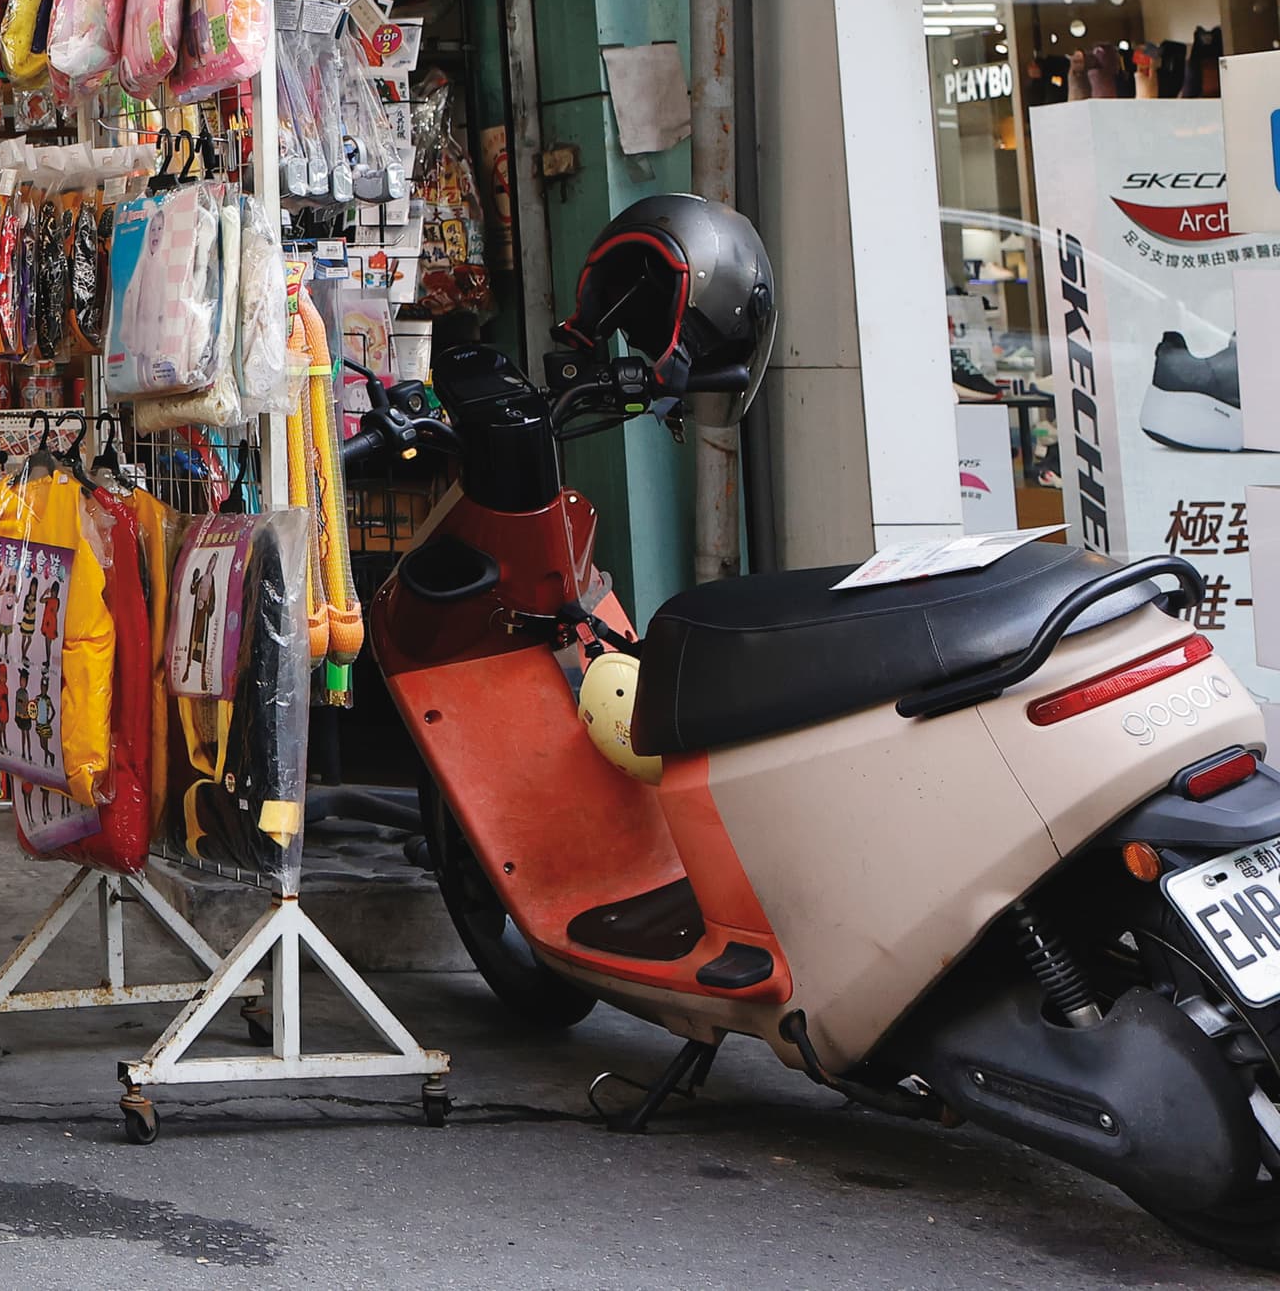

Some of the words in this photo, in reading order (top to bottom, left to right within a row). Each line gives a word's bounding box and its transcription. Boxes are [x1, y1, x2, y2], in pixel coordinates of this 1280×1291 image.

[376, 32, 399, 43] TOP
[382, 42, 391, 53] 2
[1179, 208, 1230, 232] Arch
[1121, 675, 1232, 746] gogoro
